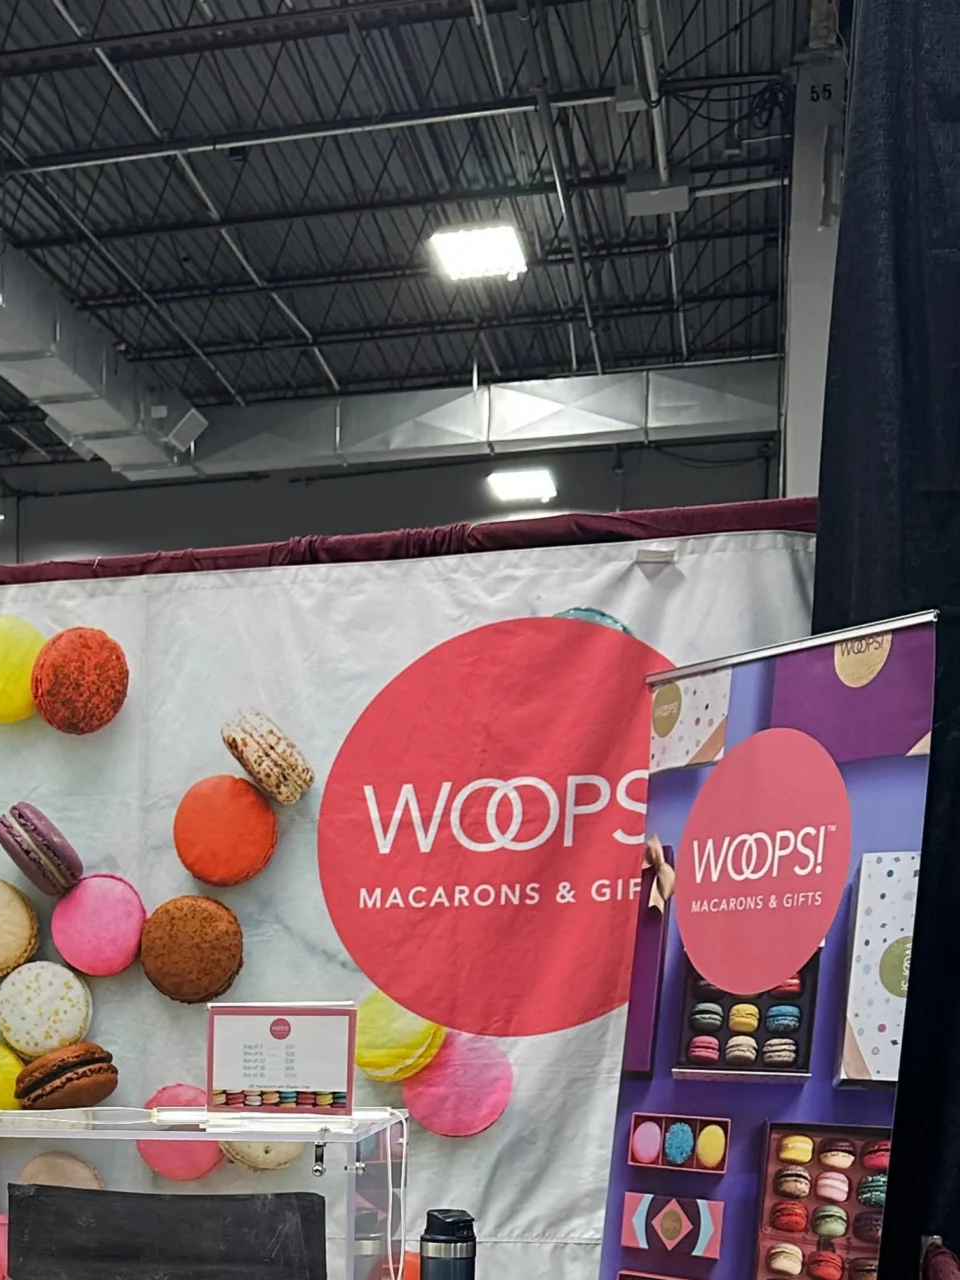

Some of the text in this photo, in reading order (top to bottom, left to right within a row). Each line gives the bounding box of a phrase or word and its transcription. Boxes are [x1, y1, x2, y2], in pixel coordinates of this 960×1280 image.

[810, 83, 832, 102] 55
[363, 769, 648, 854] WOOPS
[693, 825, 825, 884] WOOPS!
[359, 883, 540, 909] MACARONS
[555, 881, 576, 903] &
[691, 891, 822, 913] MACARONS & GIFTS
